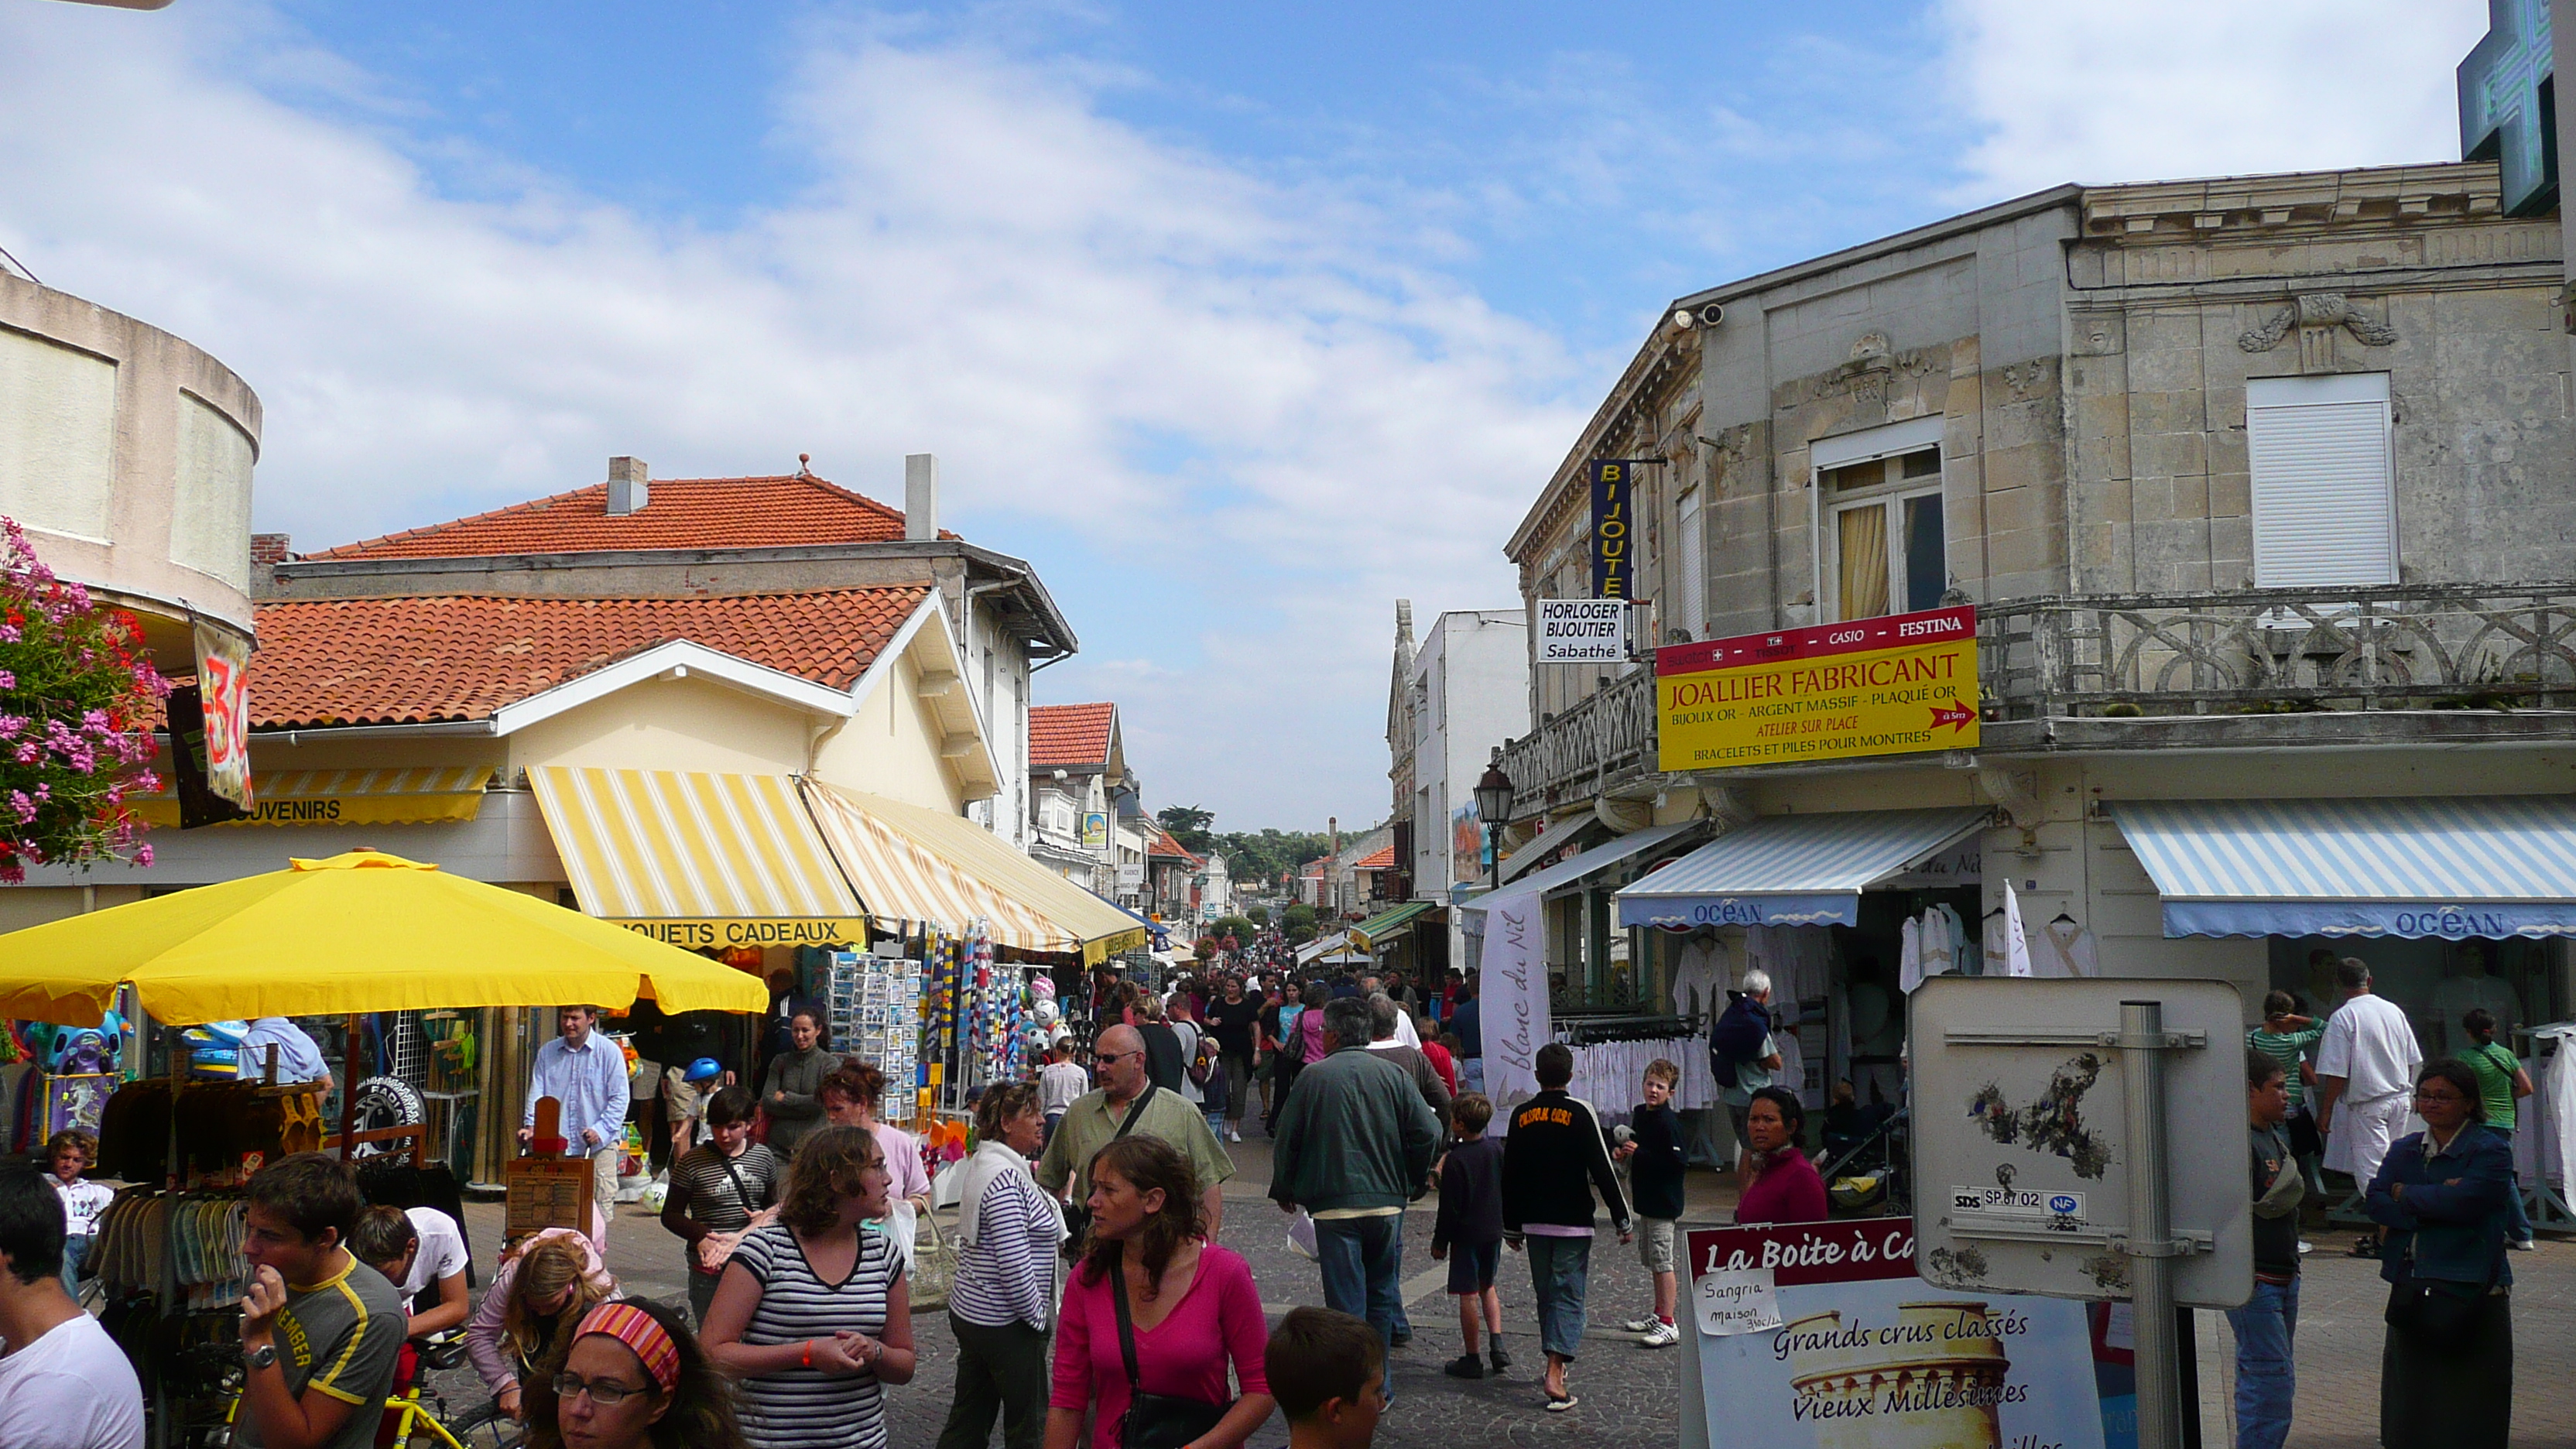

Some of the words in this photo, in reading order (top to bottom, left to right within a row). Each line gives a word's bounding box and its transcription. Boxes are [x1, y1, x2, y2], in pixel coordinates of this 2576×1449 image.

[1598, 464, 1625, 600] BIJOUTE
[1542, 603, 1619, 619] HORLOGER
[1546, 622, 1616, 638] BIJOUTIER
[1829, 629, 1865, 644] CASIO
[1899, 617, 1963, 637] FESTINA
[1547, 643, 1617, 658] Sabathé
[1756, 644, 1797, 658] TISSOT
[1668, 674, 1783, 711] JOALLIER
[1792, 653, 1959, 694] FABRICANT
[1672, 711, 1714, 726] BIJOUX
[1717, 708, 1736, 721] OR
[1748, 701, 1804, 718] ARGENT
[1806, 695, 1858, 712] MASSIF
[1872, 683, 1929, 705] PLAQUÉ
[1933, 685, 1957, 700] OR
[1756, 721, 1797, 738] ATELIER
[1800, 719, 1822, 734] SUR
[1825, 715, 1859, 731] PLACE
[1694, 745, 1761, 761] BRACELETS
[1764, 743, 1780, 755] ET
[1783, 739, 1816, 754] PILES
[1819, 737, 1857, 751] POUR
[1860, 730, 1931, 748] MONTRES
[235, 800, 341, 821] UVENIRS
[624, 923, 714, 944] OUETS
[726, 922, 841, 944] CADEAUX
[1500, 909, 1528, 951] Nil
[1501, 958, 1527, 992] du
[1500, 1002, 1532, 1071] blanc
[1954, 1195, 1981, 1208] SDS
[2020, 1193, 2040, 1206] 02
[2054, 1197, 2073, 1209] NF
[1704, 1244, 1754, 1274] La
[1850, 1230, 1876, 1262] à
[1704, 1283, 1763, 1303] Sangria
[1710, 1307, 1757, 1324] maison
[277, 1307, 311, 1367] EMBER
[1773, 1318, 1872, 1362] Grands
[1879, 1323, 1936, 1347] crus
[1943, 1309, 2030, 1341] classés
[1792, 1390, 1874, 1422] Vieux
[1883, 1381, 2029, 1415] Millésimes
